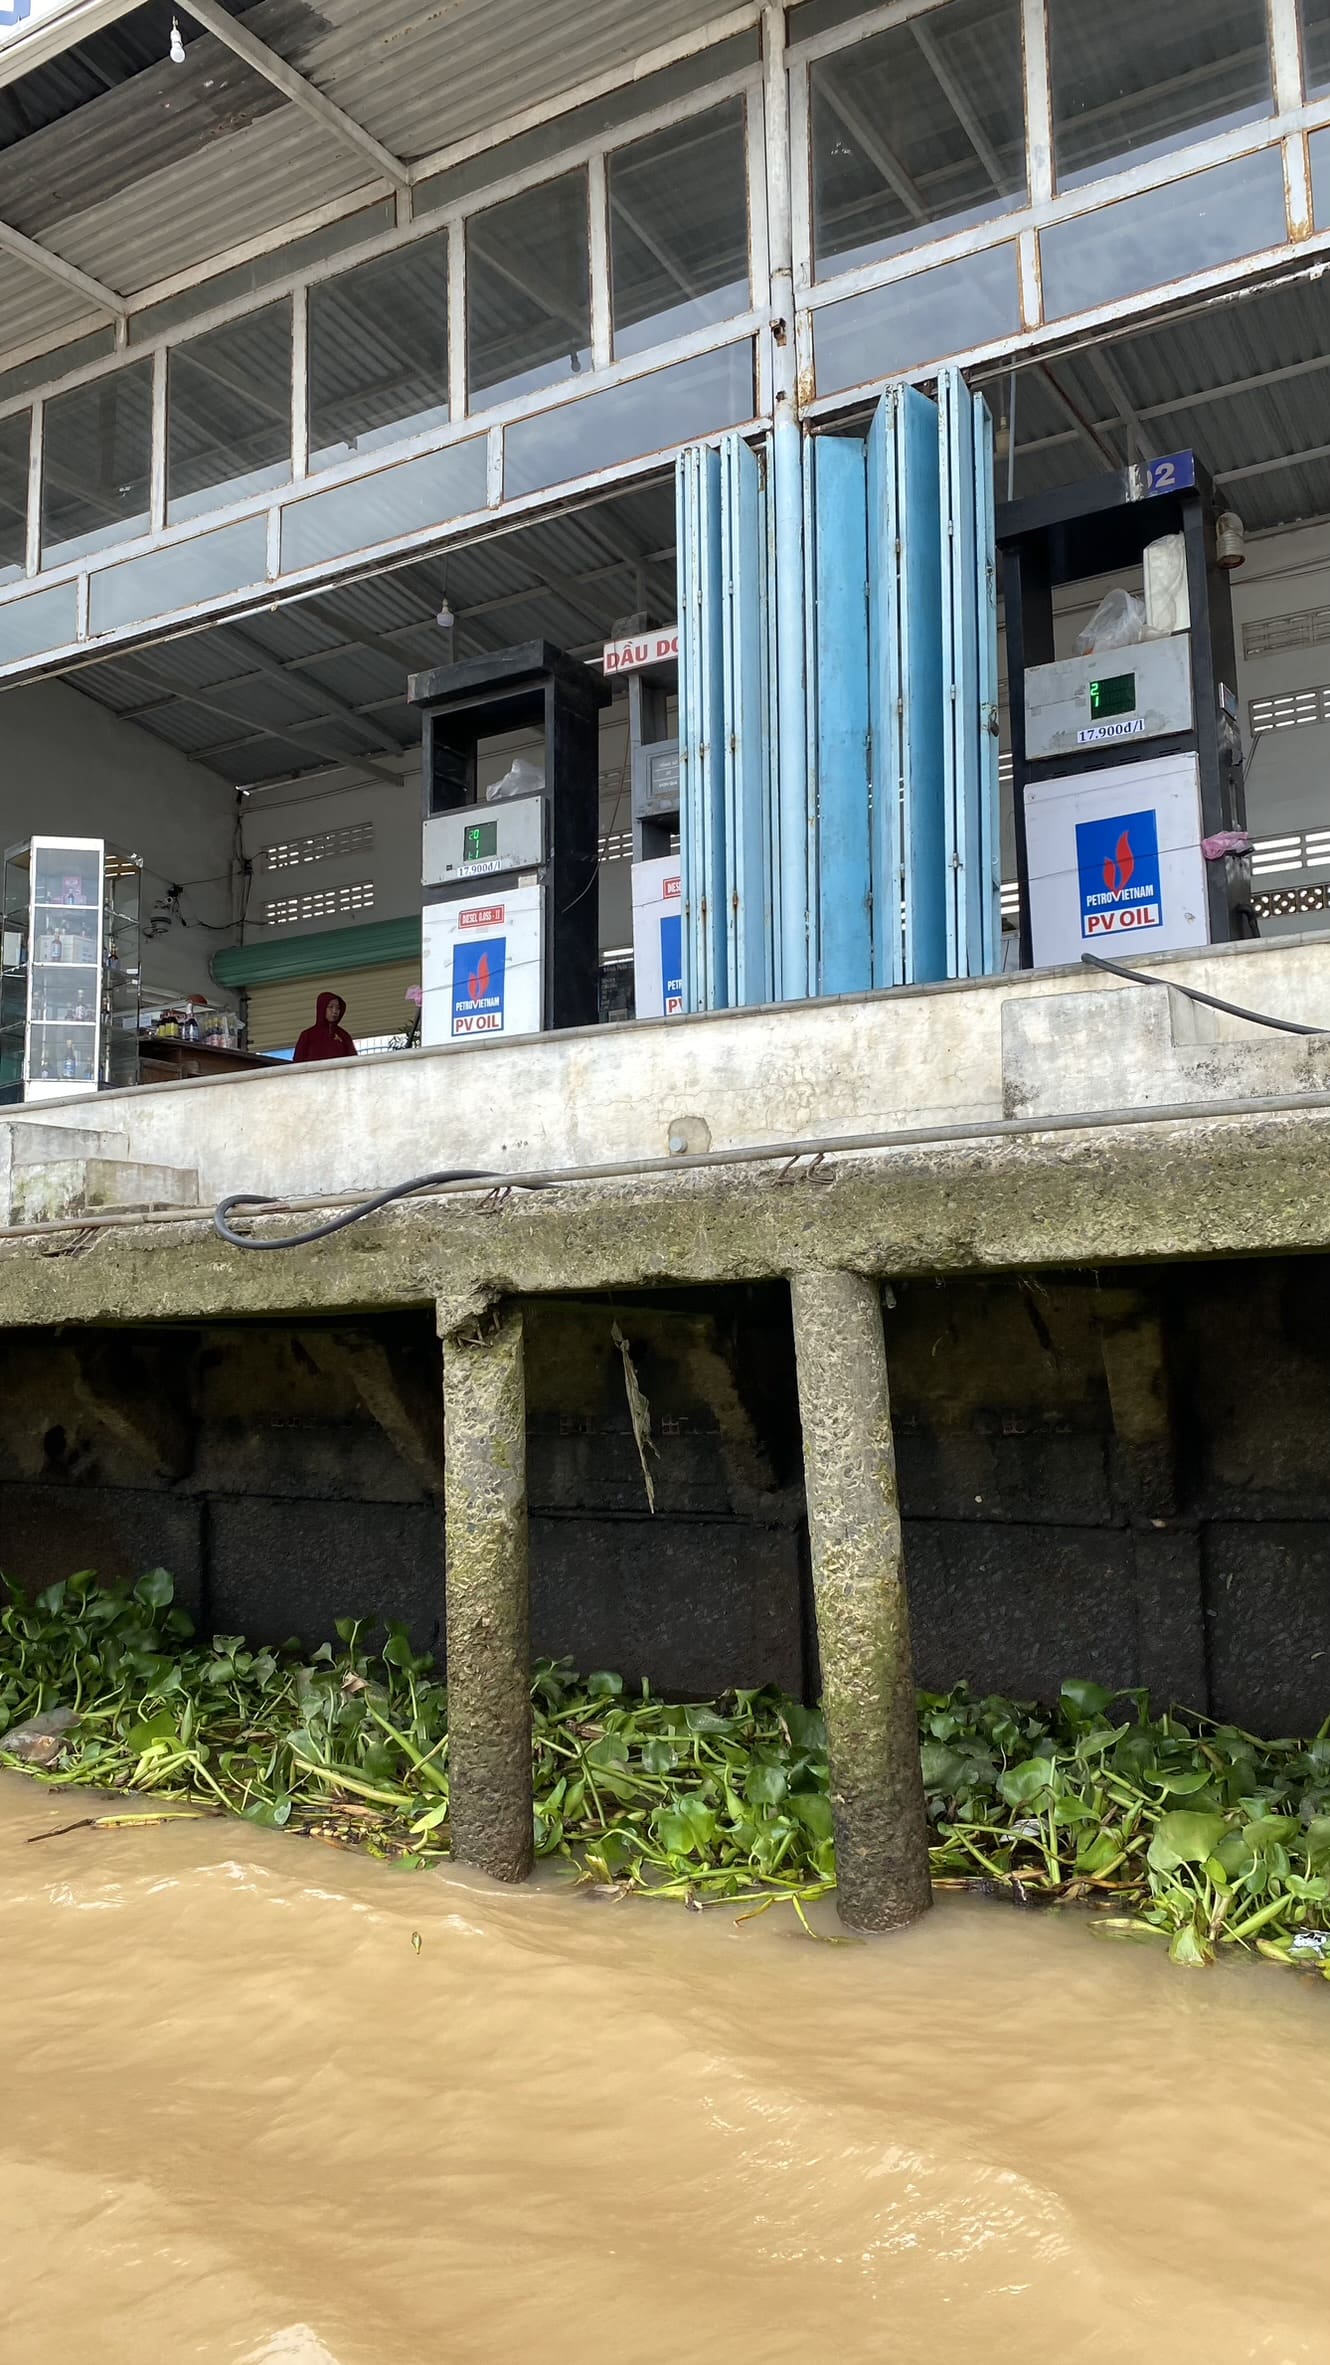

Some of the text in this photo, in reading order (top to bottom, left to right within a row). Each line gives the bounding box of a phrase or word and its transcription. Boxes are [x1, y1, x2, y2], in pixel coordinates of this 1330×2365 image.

[606, 641, 648, 669] DẦU
[1086, 884, 1154, 907] PETROVIETNAM
[461, 911, 478, 925] DIESEL
[1087, 907, 1155, 933] PV OIL
[455, 996, 500, 1012] PETROVIETNAM
[456, 1014, 500, 1033] PV OIL
